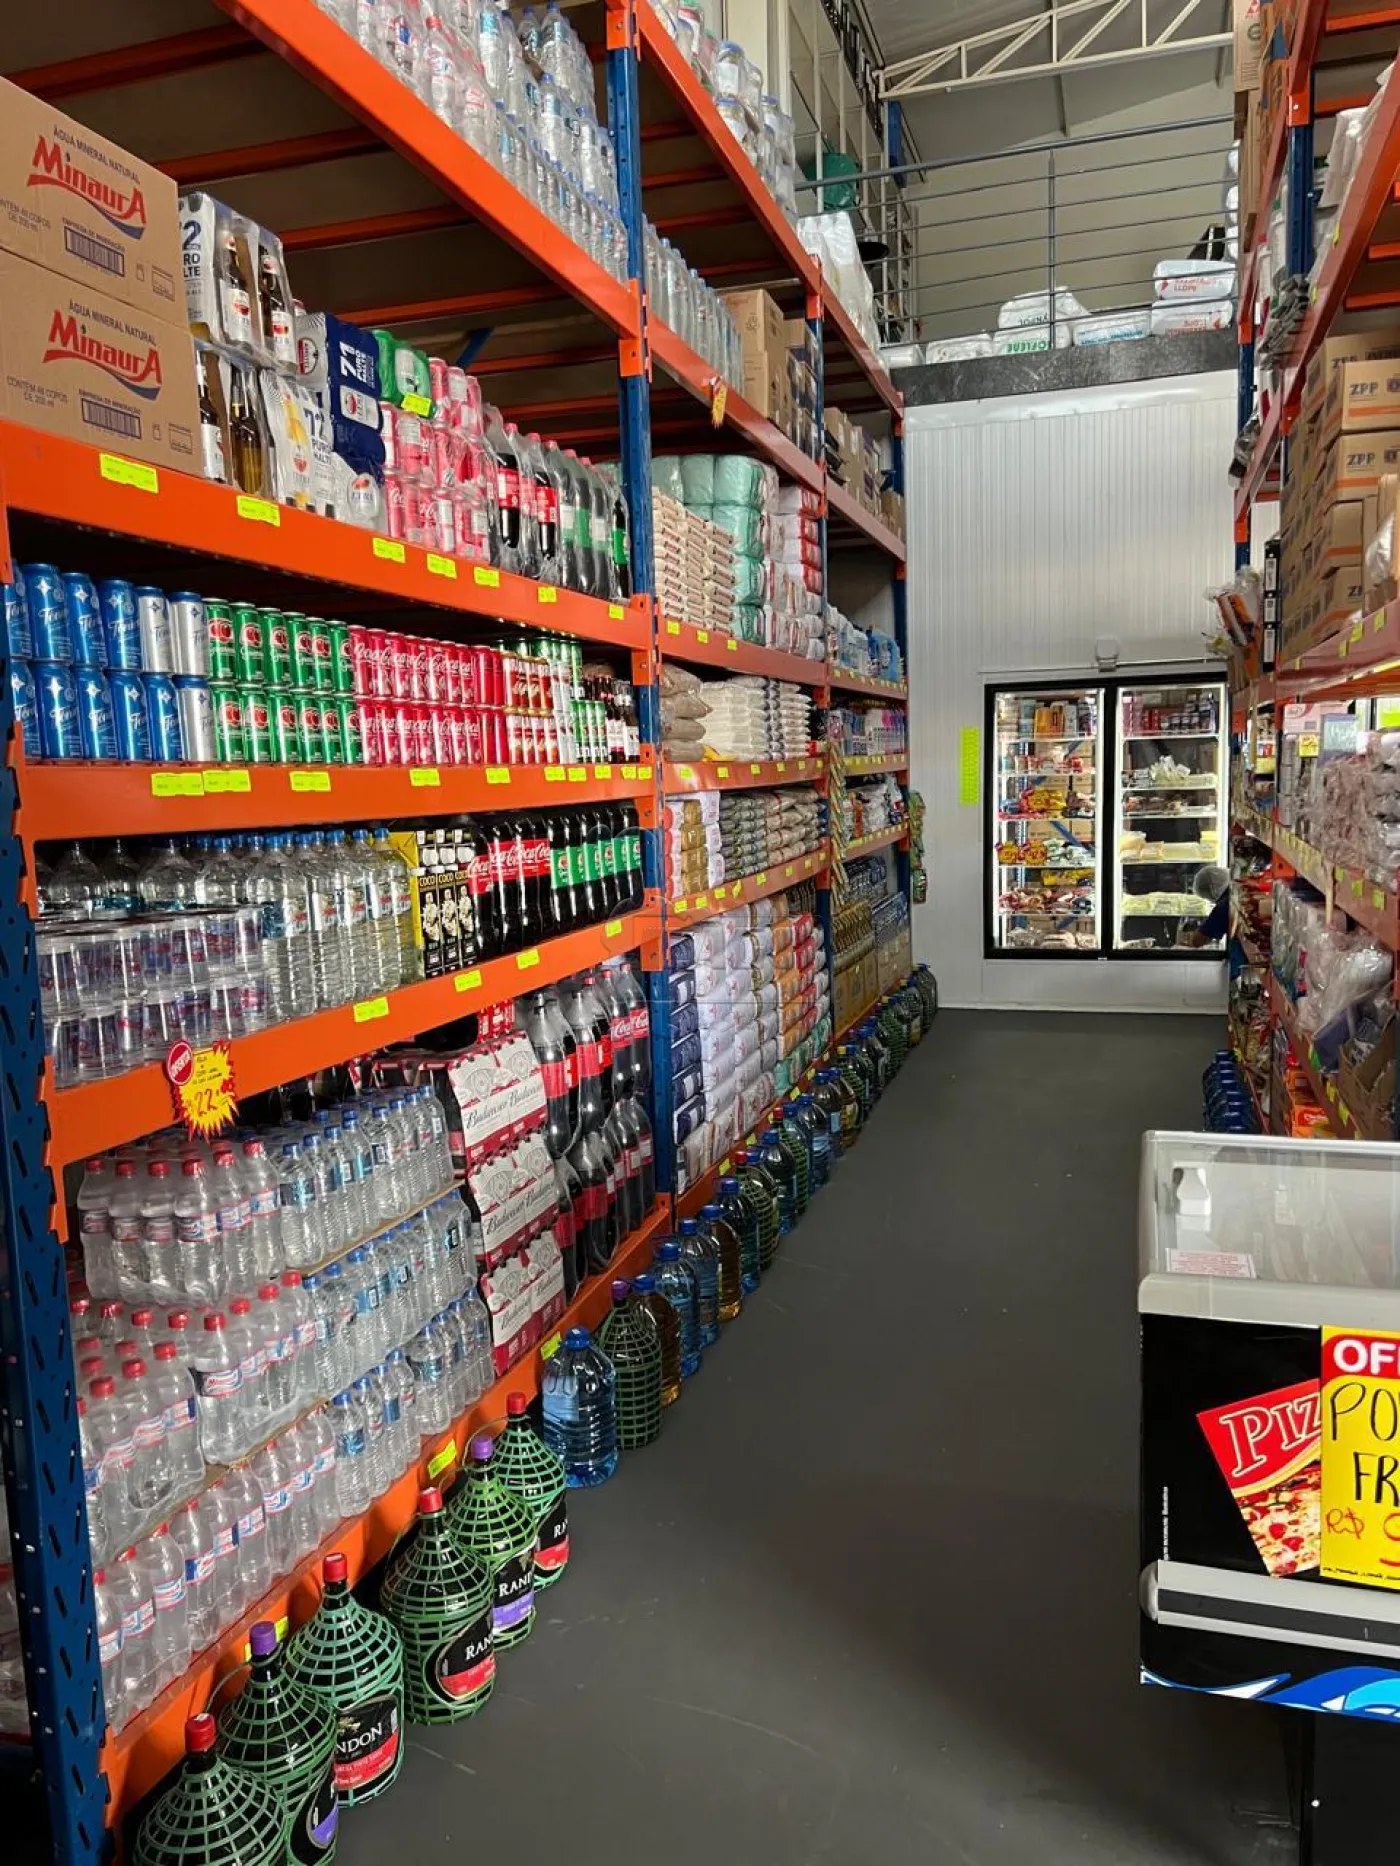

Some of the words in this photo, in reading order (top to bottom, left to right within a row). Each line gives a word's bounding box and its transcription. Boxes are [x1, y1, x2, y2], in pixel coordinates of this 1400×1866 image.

[76, 139, 109, 167] MINERAL
[92, 311, 124, 334] MINERAL
[1349, 382, 1378, 396] ZPP
[1347, 452, 1375, 467] ZPP
[419, 875, 436, 888] COCO
[438, 872, 454, 885] COCO
[1333, 1338, 1400, 1375] OF
[1329, 1381, 1400, 1441] PO
[1325, 1507, 1365, 1540] R$
